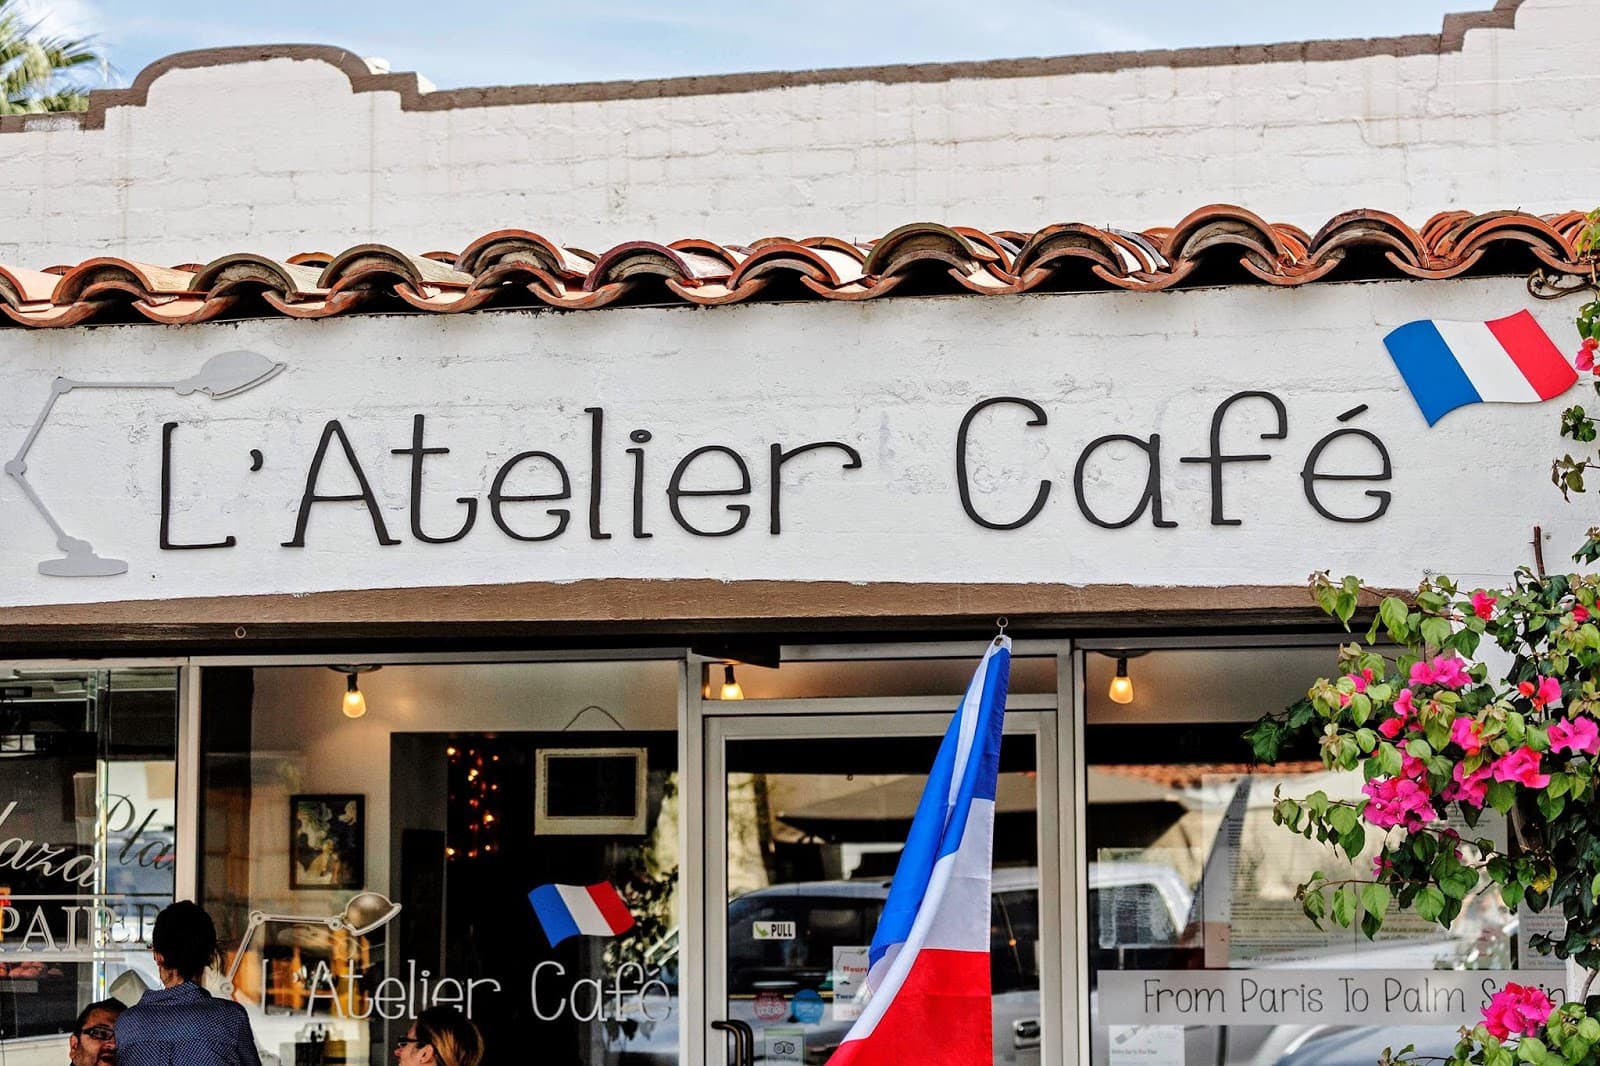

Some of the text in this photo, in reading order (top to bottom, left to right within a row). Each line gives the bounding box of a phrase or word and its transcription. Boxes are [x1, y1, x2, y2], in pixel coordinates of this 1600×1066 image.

[160, 391, 1391, 550] L'Atelier Café
[771, 923, 792, 937] PULL
[261, 958, 672, 1022] L'Atelier Café
[1144, 979, 1226, 1014] From
[1241, 978, 1323, 1013] Paris
[1338, 977, 1369, 1012] To
[1384, 977, 1466, 1013] Palm
